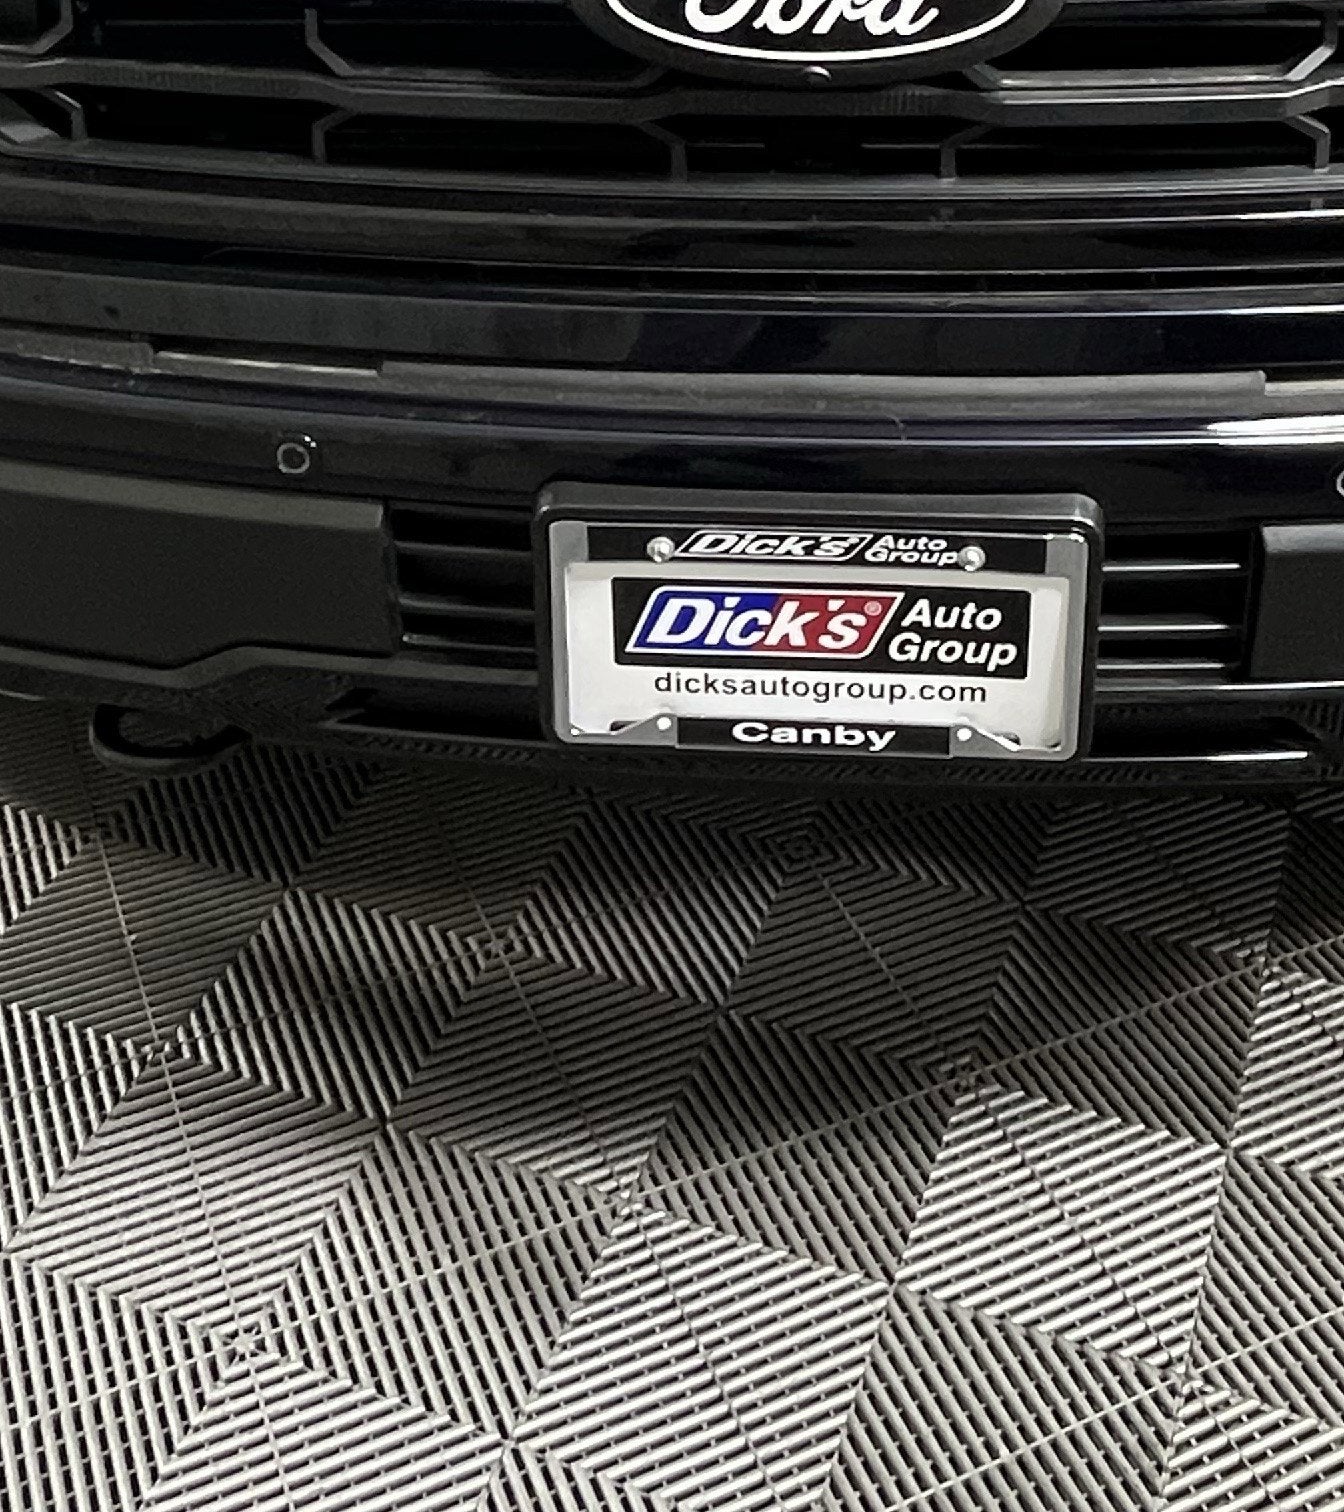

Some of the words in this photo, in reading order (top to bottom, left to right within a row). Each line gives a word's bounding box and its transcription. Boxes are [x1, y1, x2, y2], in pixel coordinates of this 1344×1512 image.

[864, 547, 958, 566] Group
[871, 534, 947, 551] Auto
[901, 599, 1002, 632] Auto
[888, 632, 1017, 671] Group
[654, 672, 987, 704] dicksautogroup.com
[732, 723, 896, 752] Canby
